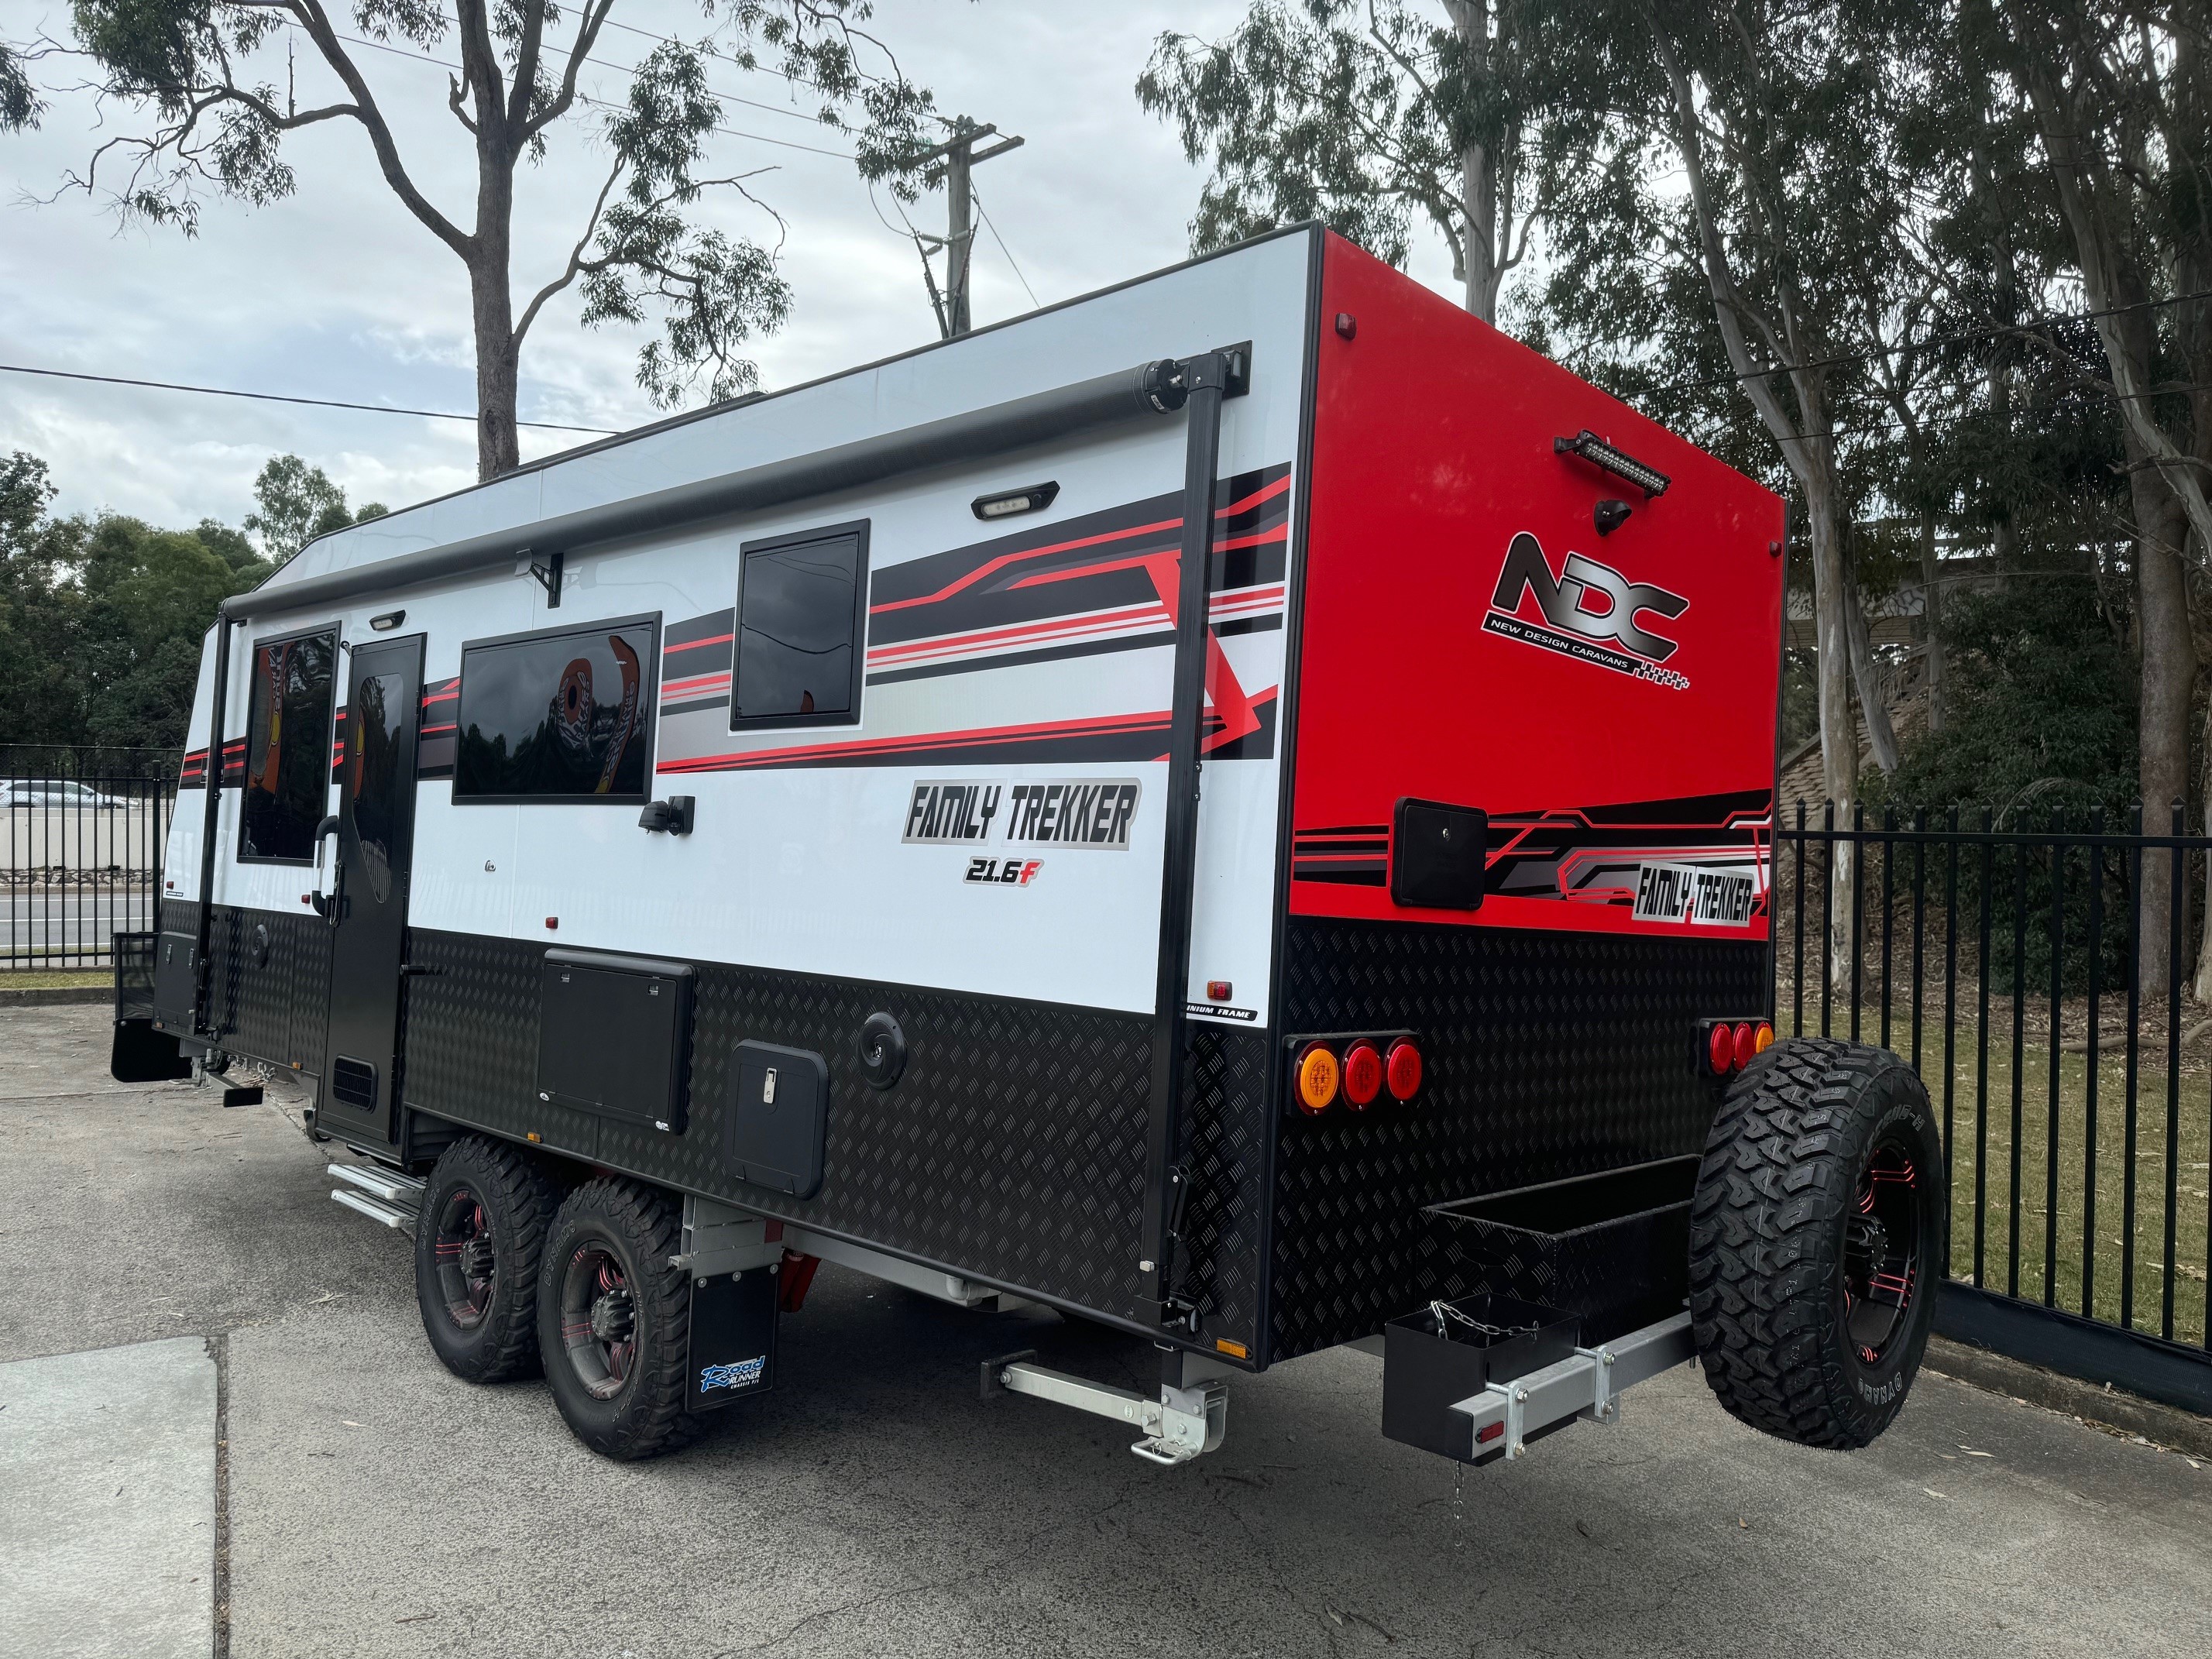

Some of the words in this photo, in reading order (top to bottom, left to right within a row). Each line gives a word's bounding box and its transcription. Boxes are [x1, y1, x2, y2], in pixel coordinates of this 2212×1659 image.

[1491, 531, 1690, 663] NDC
[1490, 619, 1521, 634] NEW
[1524, 630, 1569, 650] DESIGN
[1571, 645, 1629, 668] CARAVANS
[906, 785, 1002, 840] FAMILY
[1007, 785, 1138, 843] TREKKER
[1636, 867, 1692, 917] FAMILY
[1694, 874, 1753, 922] TREKKER
[1187, 1005, 1214, 1014] INIUM
[1218, 1008, 1251, 1018] FRAME
[544, 1219, 576, 1286] DYNAMO
[700, 1355, 766, 1393] Road
[729, 1370, 761, 1385] RUNNER
